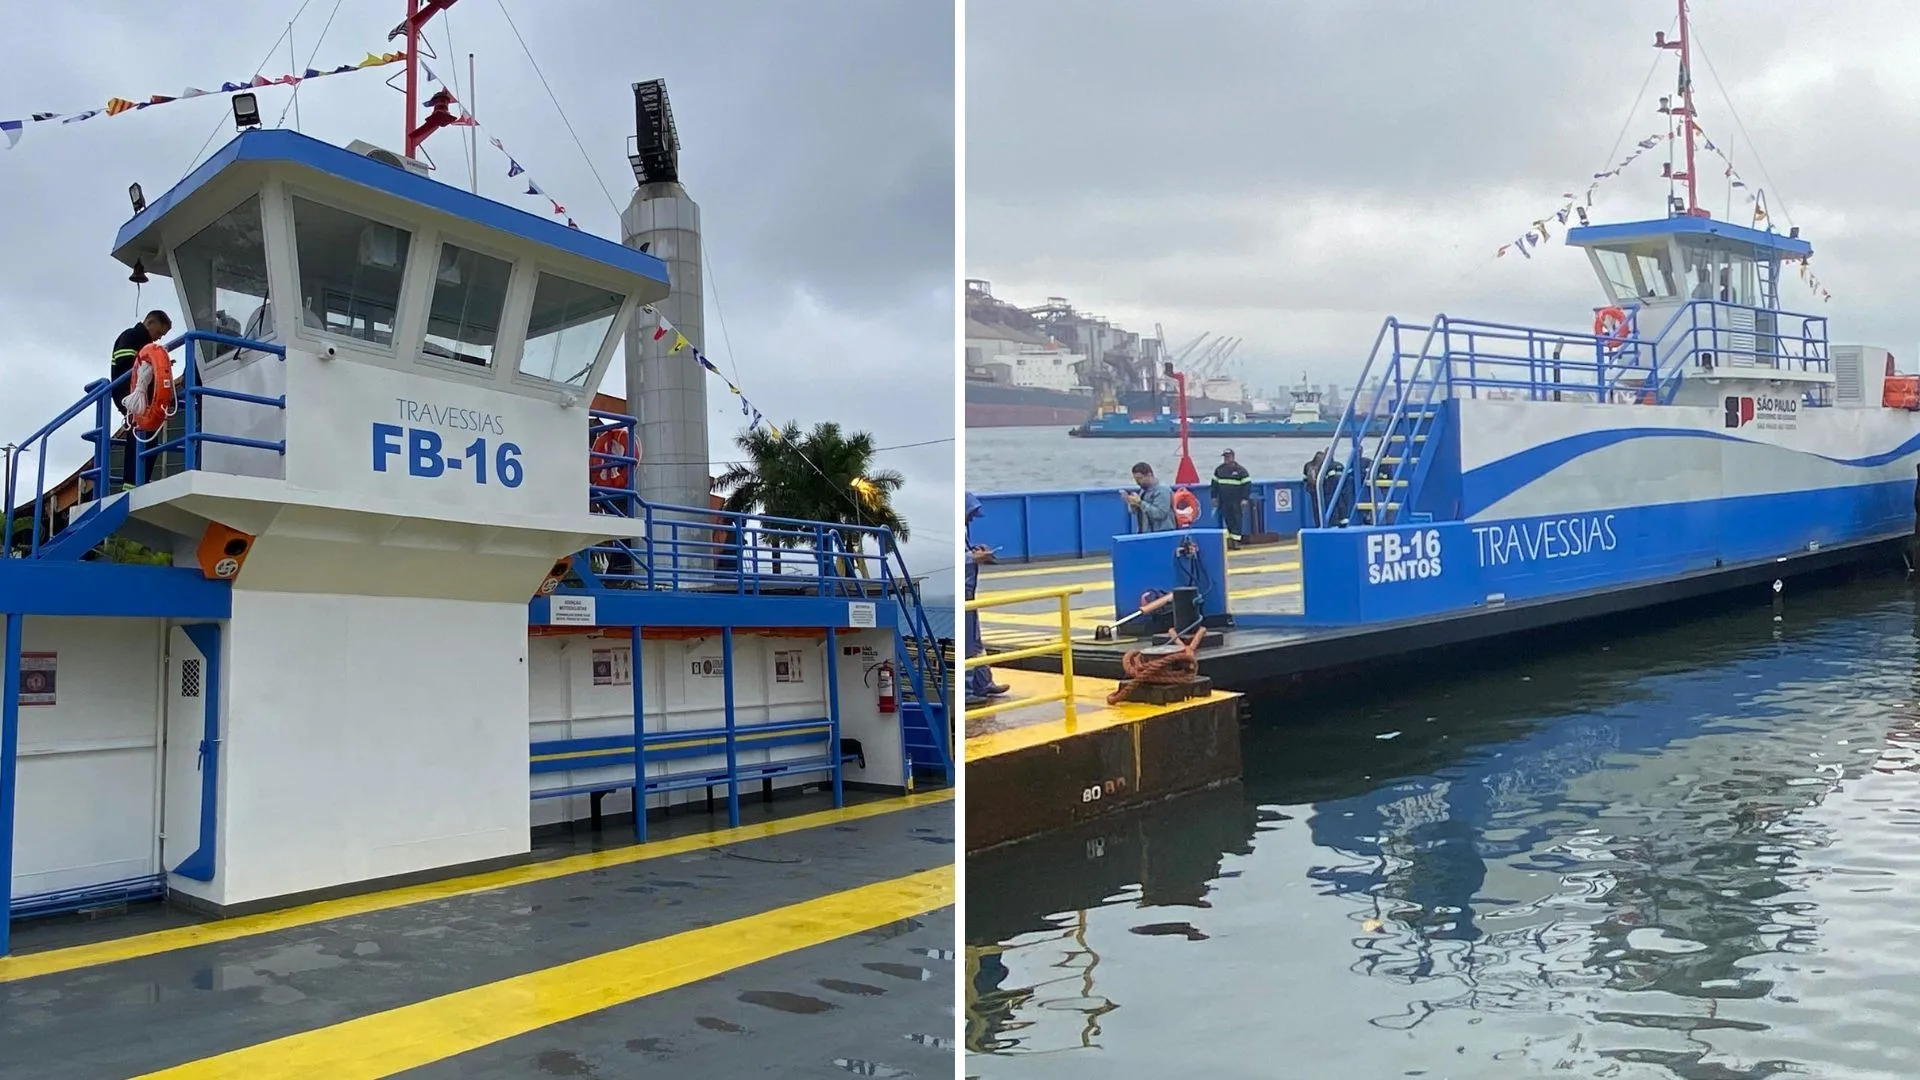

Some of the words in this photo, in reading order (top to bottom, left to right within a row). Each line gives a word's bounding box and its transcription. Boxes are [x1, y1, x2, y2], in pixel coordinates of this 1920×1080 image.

[396, 398, 504, 435] TRAVESSIAS
[1757, 394, 1773, 411] SÃO
[1774, 398, 1796, 412] PAULO
[372, 422, 523, 488] FB-16
[1367, 529, 1441, 564] FB-16
[1472, 515, 1616, 567] TRAVESSIAS
[1368, 557, 1441, 585] SANTOS
